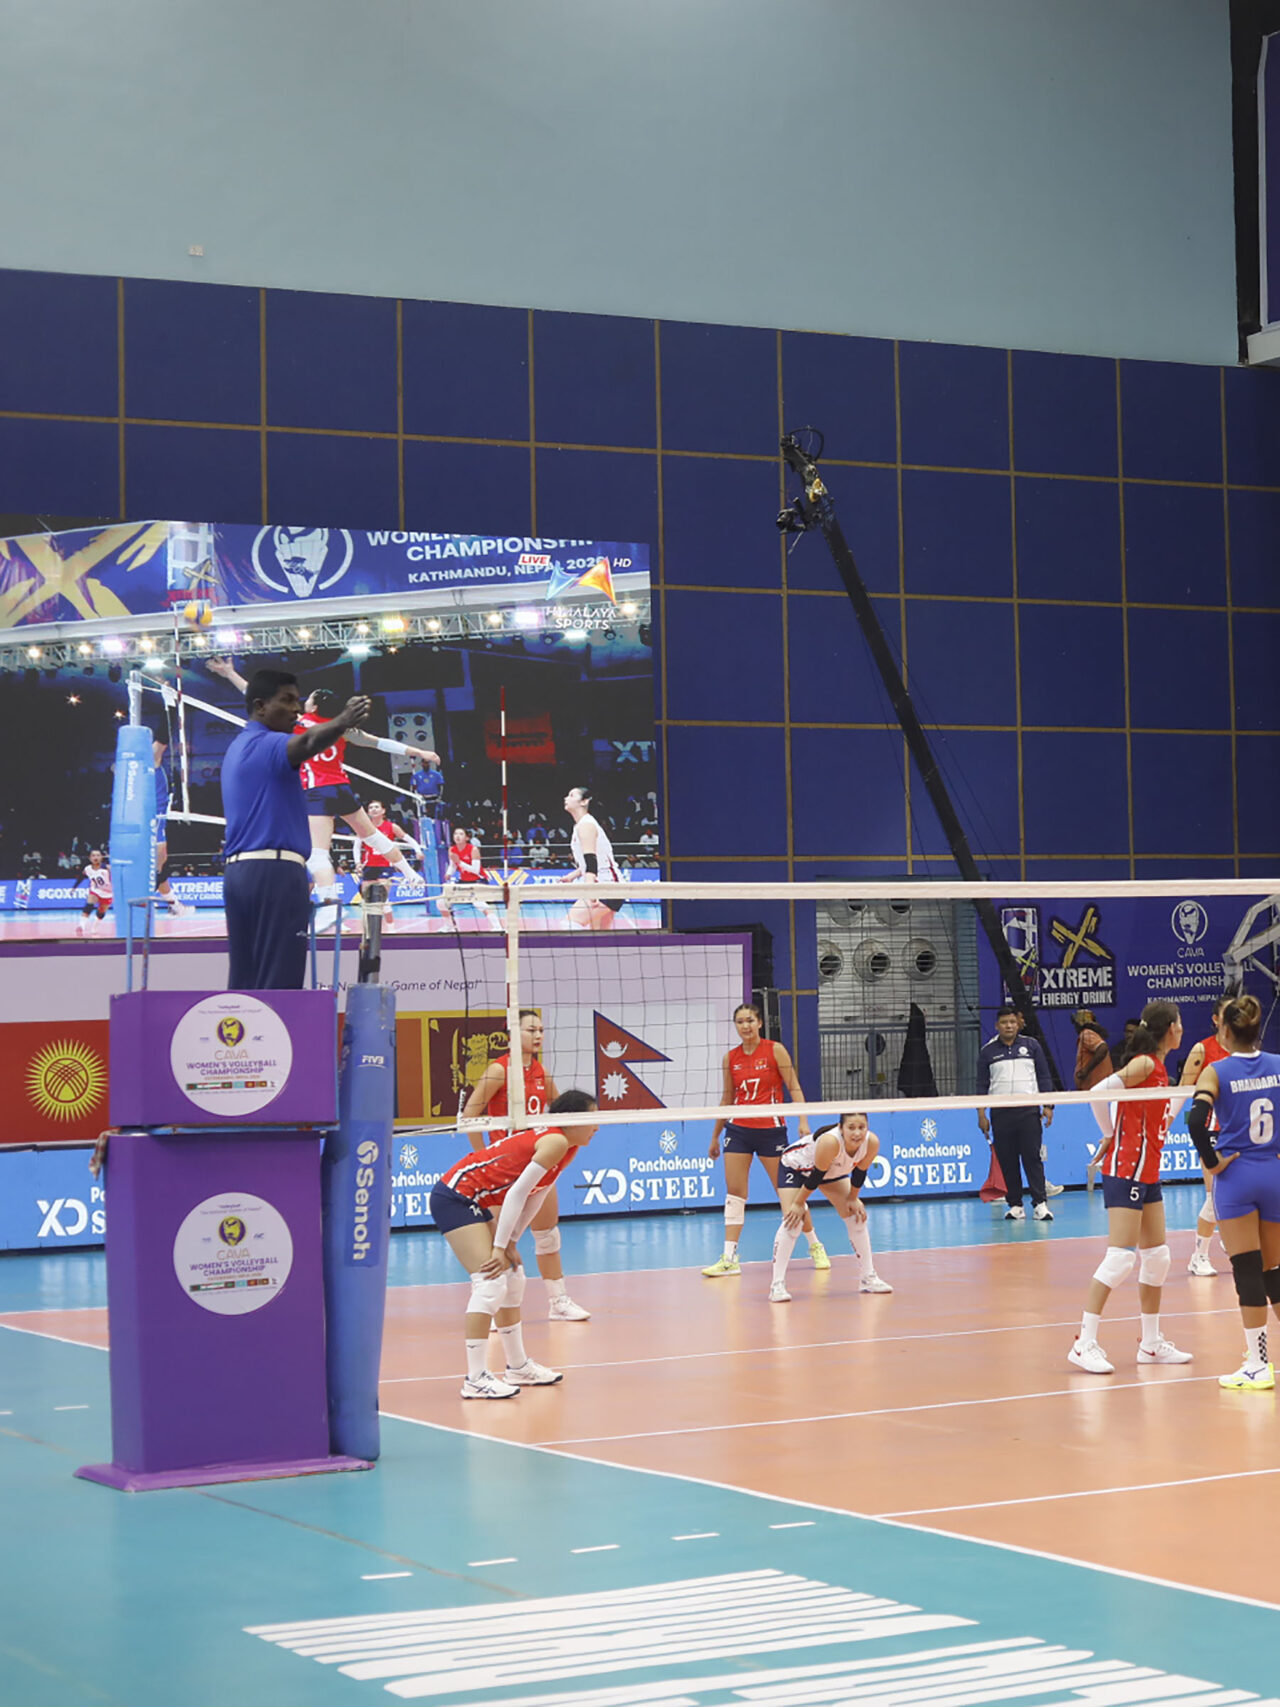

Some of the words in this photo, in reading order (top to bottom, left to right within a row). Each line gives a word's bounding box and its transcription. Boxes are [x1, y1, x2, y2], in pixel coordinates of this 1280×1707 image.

[520, 554, 549, 566] LIVE
[613, 557, 632, 568] HD
[408, 565, 512, 583] KATHMANDU,
[546, 606, 617, 618] HIMALAYA
[555, 619, 610, 630] SPORTS
[172, 881, 224, 893] XTREME
[1177, 947, 1204, 958] CAVA
[1128, 963, 1183, 976] WOMEN'S
[1186, 961, 1255, 974] VOLLEYLL
[1041, 966, 1112, 988] XTREME
[1147, 976, 1225, 989] CHAMPIONSH
[391, 980, 425, 991] Game
[429, 980, 441, 991] of
[1042, 992, 1080, 1006] ENERGY
[1082, 990, 1112, 1005] DRINK
[214, 1049, 248, 1060] CAVA
[186, 1061, 227, 1070] WOMEN'S
[229, 1060, 276, 1068] VOLLEYBALL
[200, 1067, 264, 1076] CHAMPIONSHIP
[740, 1078, 760, 1101] 17
[1249, 1098, 1274, 1144] 6
[893, 1143, 971, 1159] Panchakanya
[629, 1156, 714, 1173] Panchakanya
[1159, 1150, 1202, 1171] EEL
[785, 1173, 794, 1184] 2
[894, 1162, 972, 1187] STEEL
[582, 1168, 627, 1204] XD
[630, 1175, 715, 1202] STEEL
[1129, 1186, 1139, 1201] 5
[37, 1198, 88, 1237] XD
[353, 1167, 375, 1261] Senoh
[216, 1248, 250, 1260] CAVA
[190, 1261, 229, 1271] WOMEN'S
[230, 1257, 278, 1267] VOLLEYBALL
[203, 1265, 266, 1276] CHAMPIONSHIP
